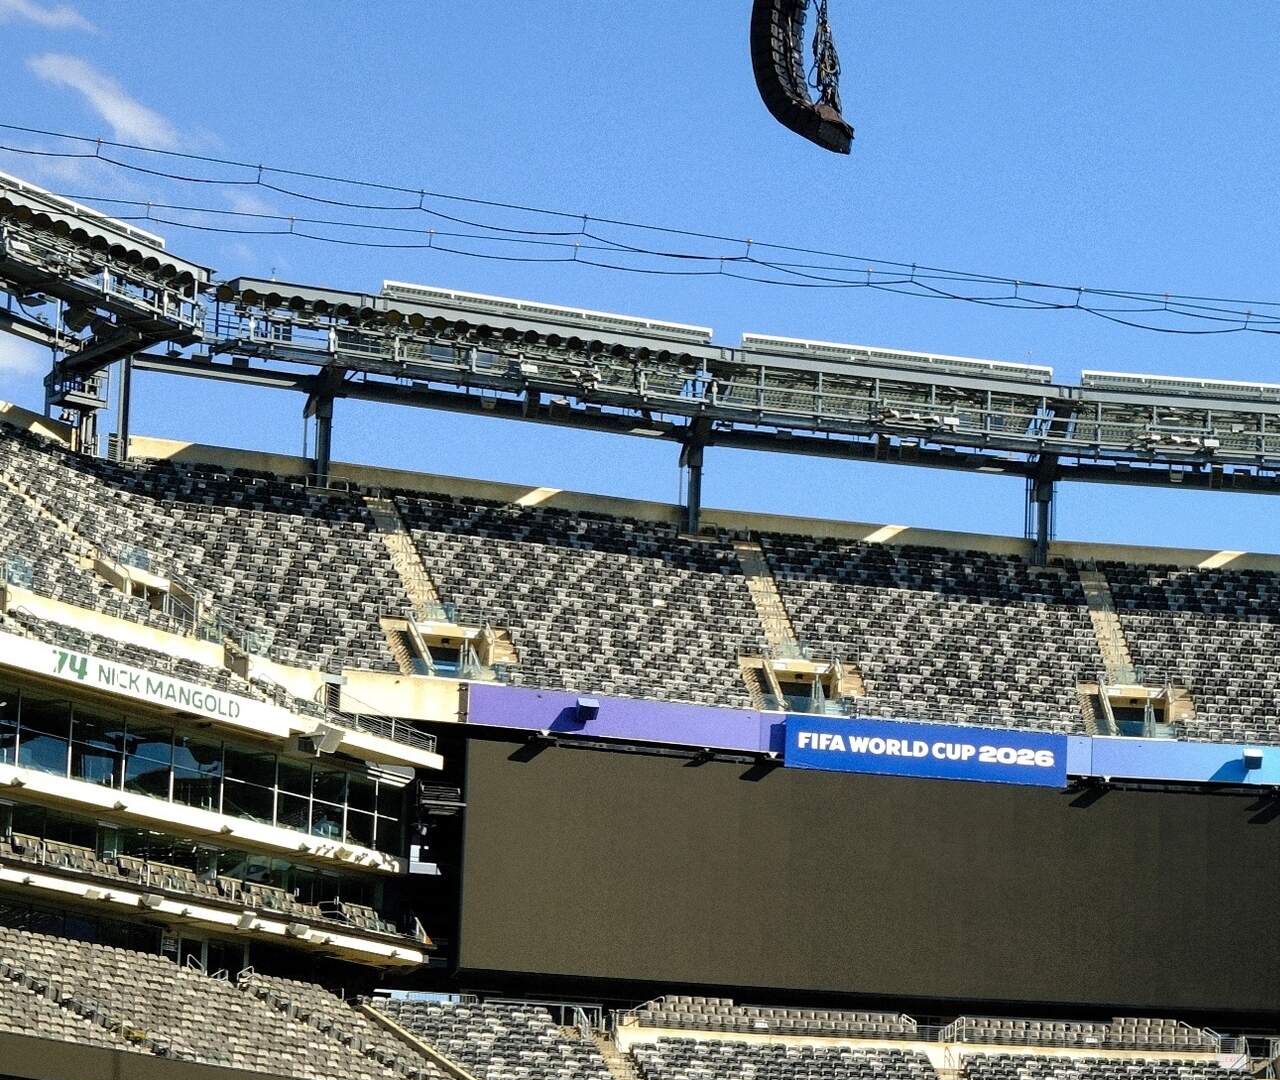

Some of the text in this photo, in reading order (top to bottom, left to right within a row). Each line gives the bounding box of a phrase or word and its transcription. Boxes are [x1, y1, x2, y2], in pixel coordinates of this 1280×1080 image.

[53, 649, 241, 718] 74 NICK MANGOLD
[798, 731, 1056, 767] FIFA WORLD CUP 2026
